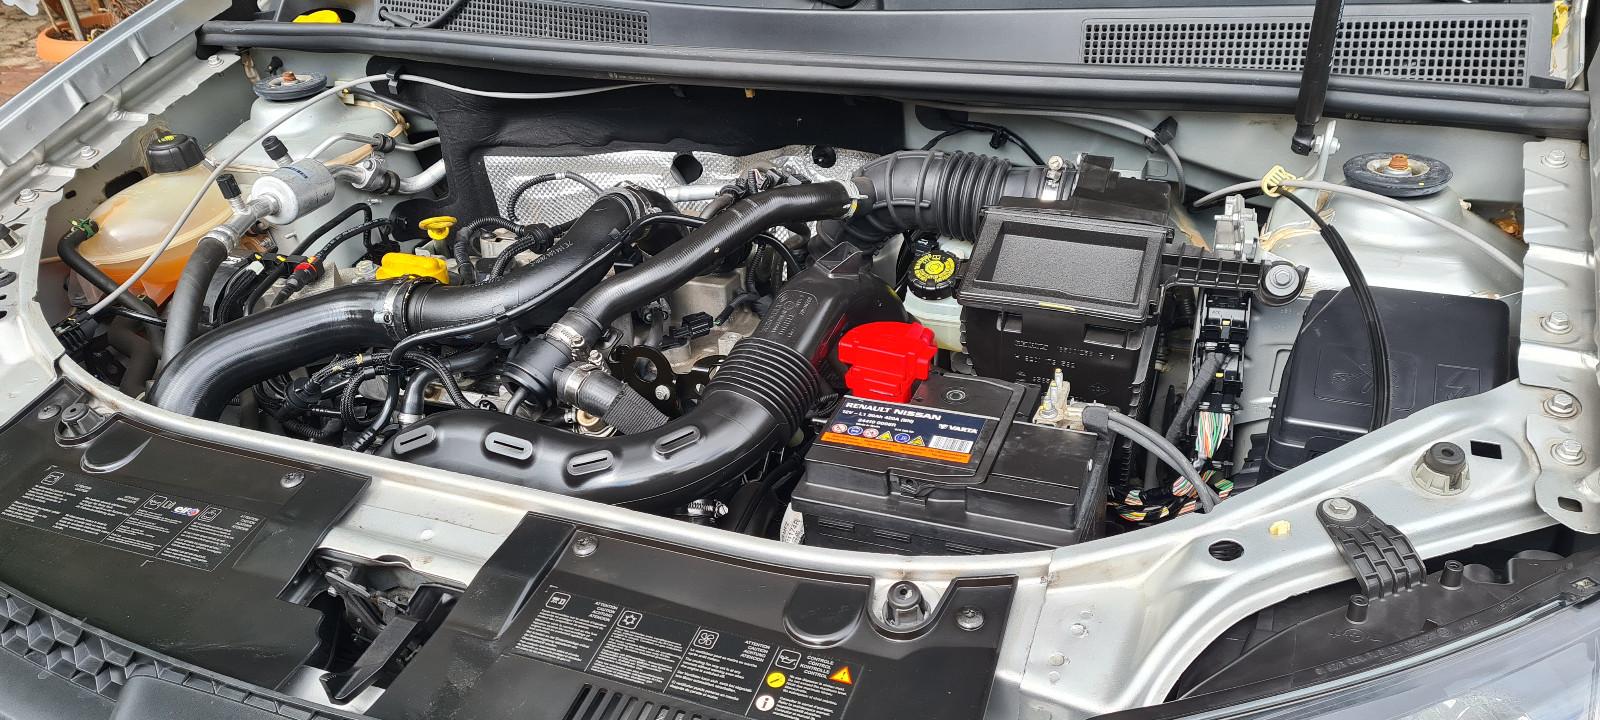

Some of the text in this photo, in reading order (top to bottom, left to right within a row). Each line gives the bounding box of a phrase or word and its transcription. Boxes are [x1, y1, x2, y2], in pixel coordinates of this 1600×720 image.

[846, 402, 942, 420] RENAULT NISSAN
[950, 426, 978, 434] VARTA
[595, 602, 618, 610] ATTENTION
[745, 641, 770, 650] ATTENTION
[747, 646, 768, 654] CAUTION
[800, 664, 830, 674] KONTROLLE
[808, 660, 831, 669] CONTROL
[804, 670, 828, 679] CONTROL
